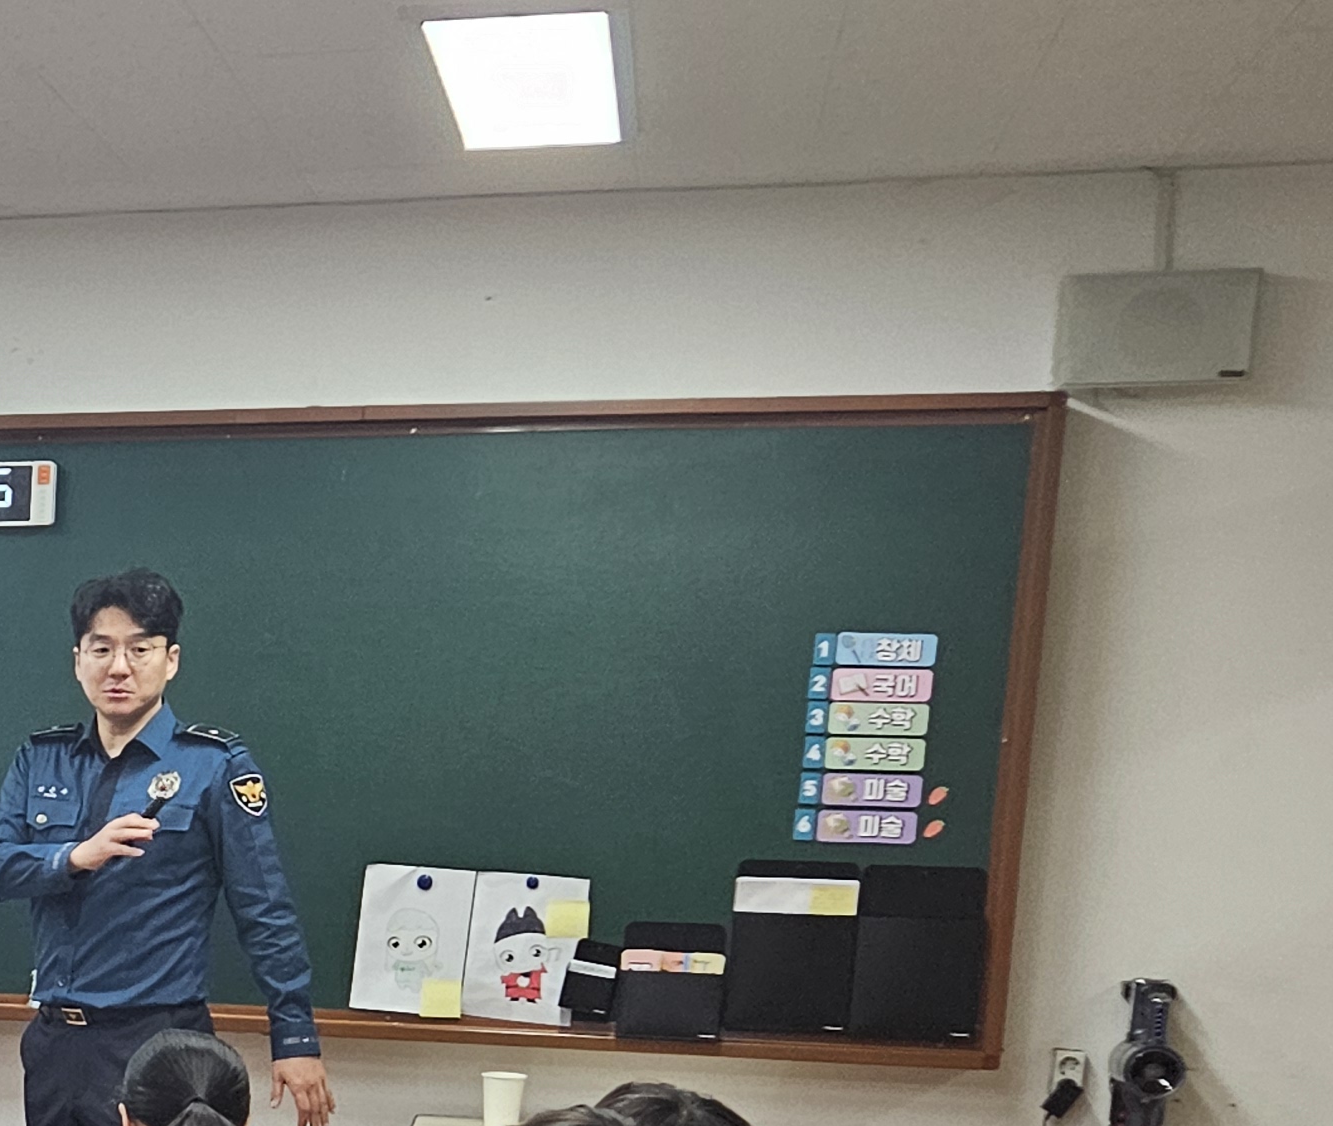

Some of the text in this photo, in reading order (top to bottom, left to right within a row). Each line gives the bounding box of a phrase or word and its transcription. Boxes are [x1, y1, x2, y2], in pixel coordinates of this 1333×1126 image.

[817, 637, 923, 662] 1 창체
[810, 674, 918, 698] 2 국어
[808, 707, 917, 731] 3 수학
[806, 742, 913, 766] 4 수학
[802, 778, 909, 802] 5 미술
[796, 814, 904, 839] 6 미술
